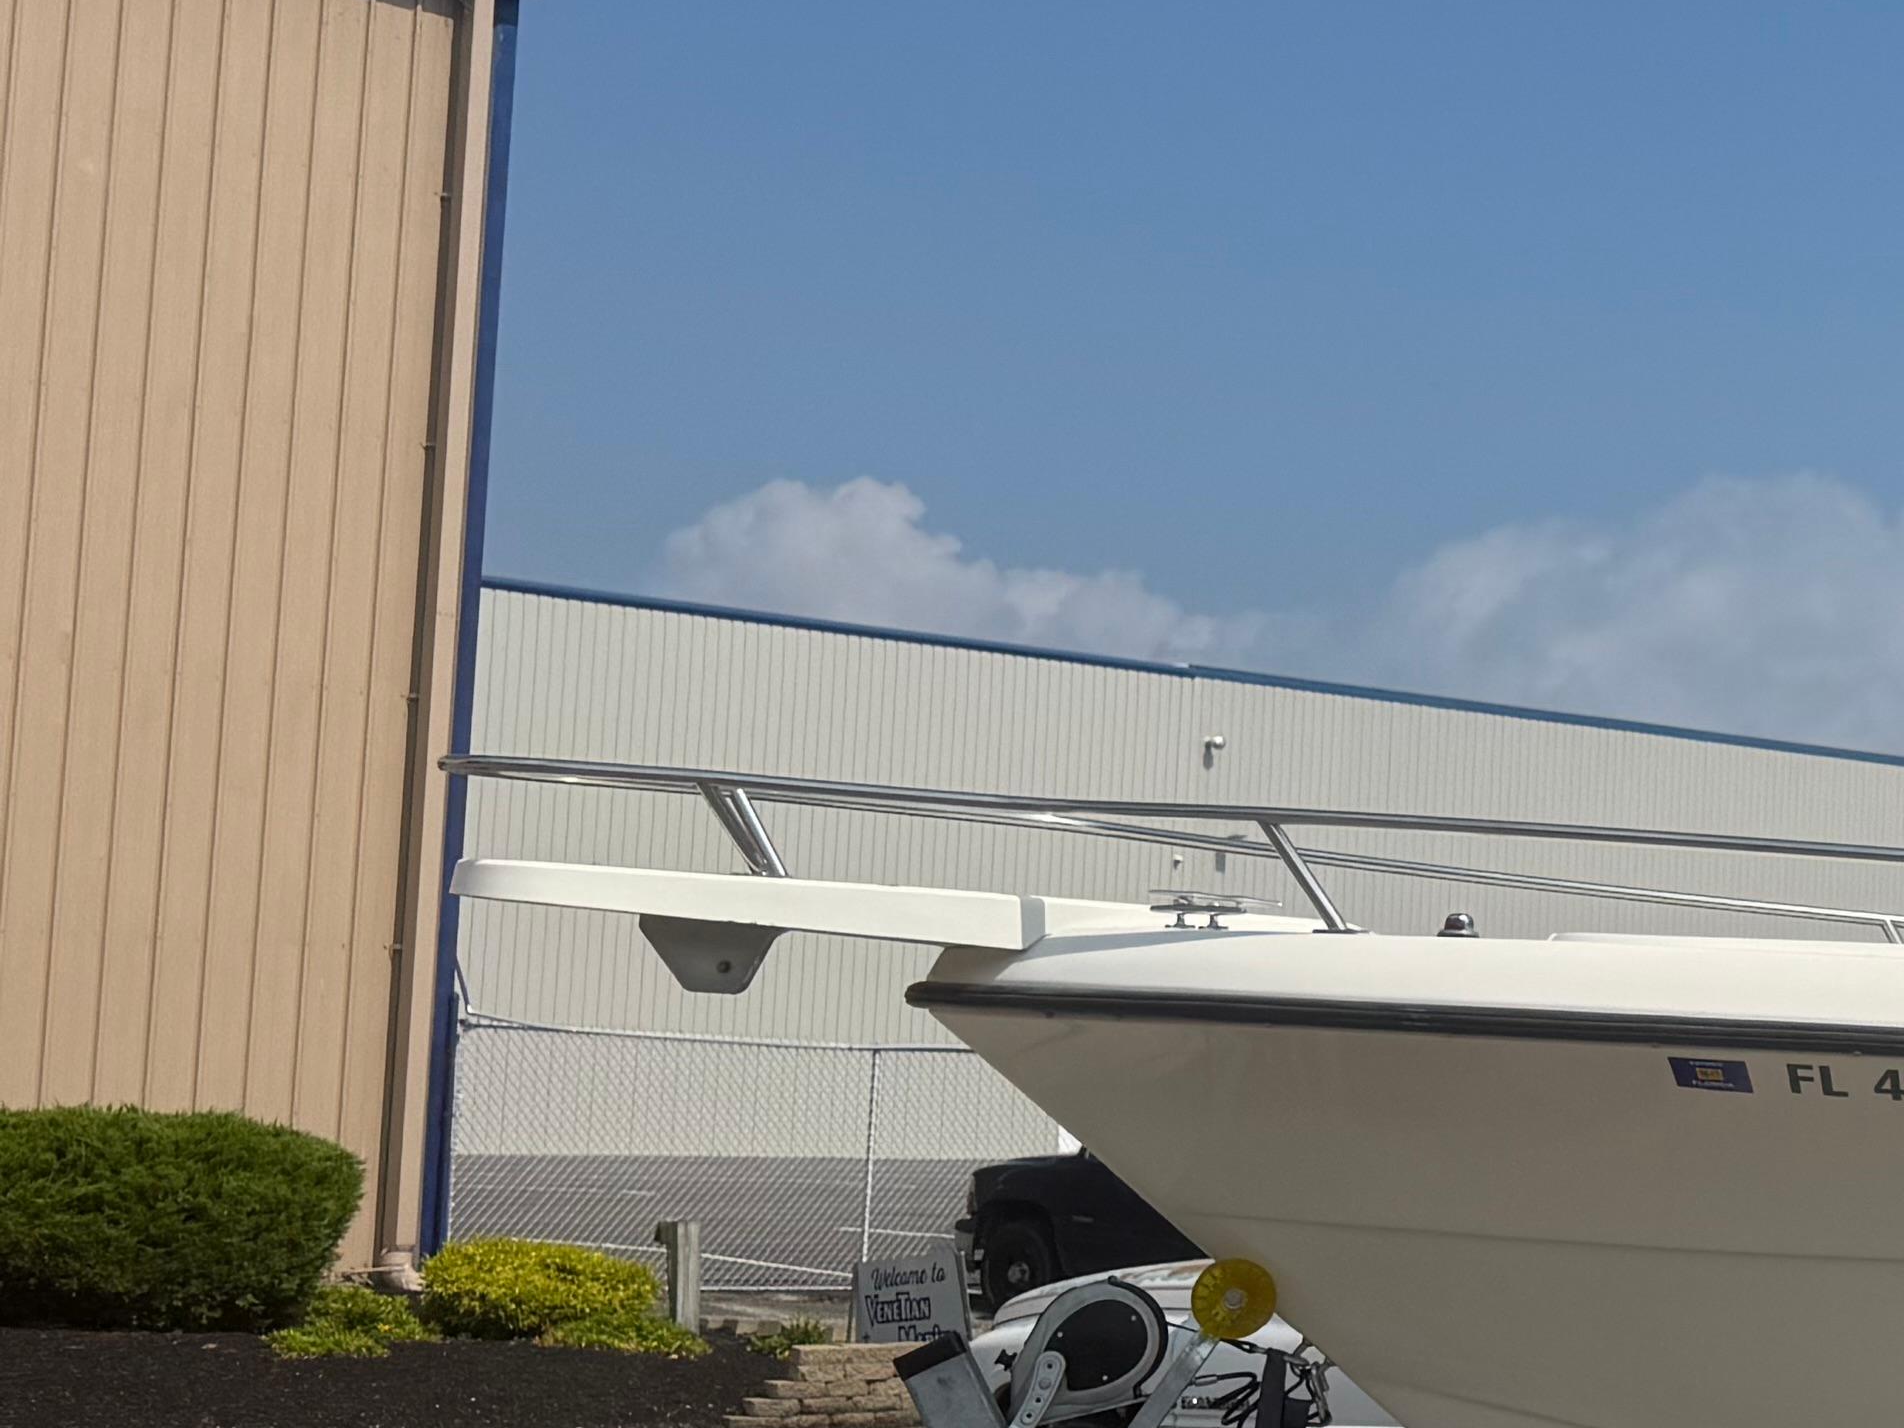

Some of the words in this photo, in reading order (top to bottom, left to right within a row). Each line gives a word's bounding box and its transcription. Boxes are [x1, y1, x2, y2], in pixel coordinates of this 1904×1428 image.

[1786, 1063, 1849, 1098] FL
[871, 1266, 928, 1291] Welcome
[931, 1262, 946, 1283] to
